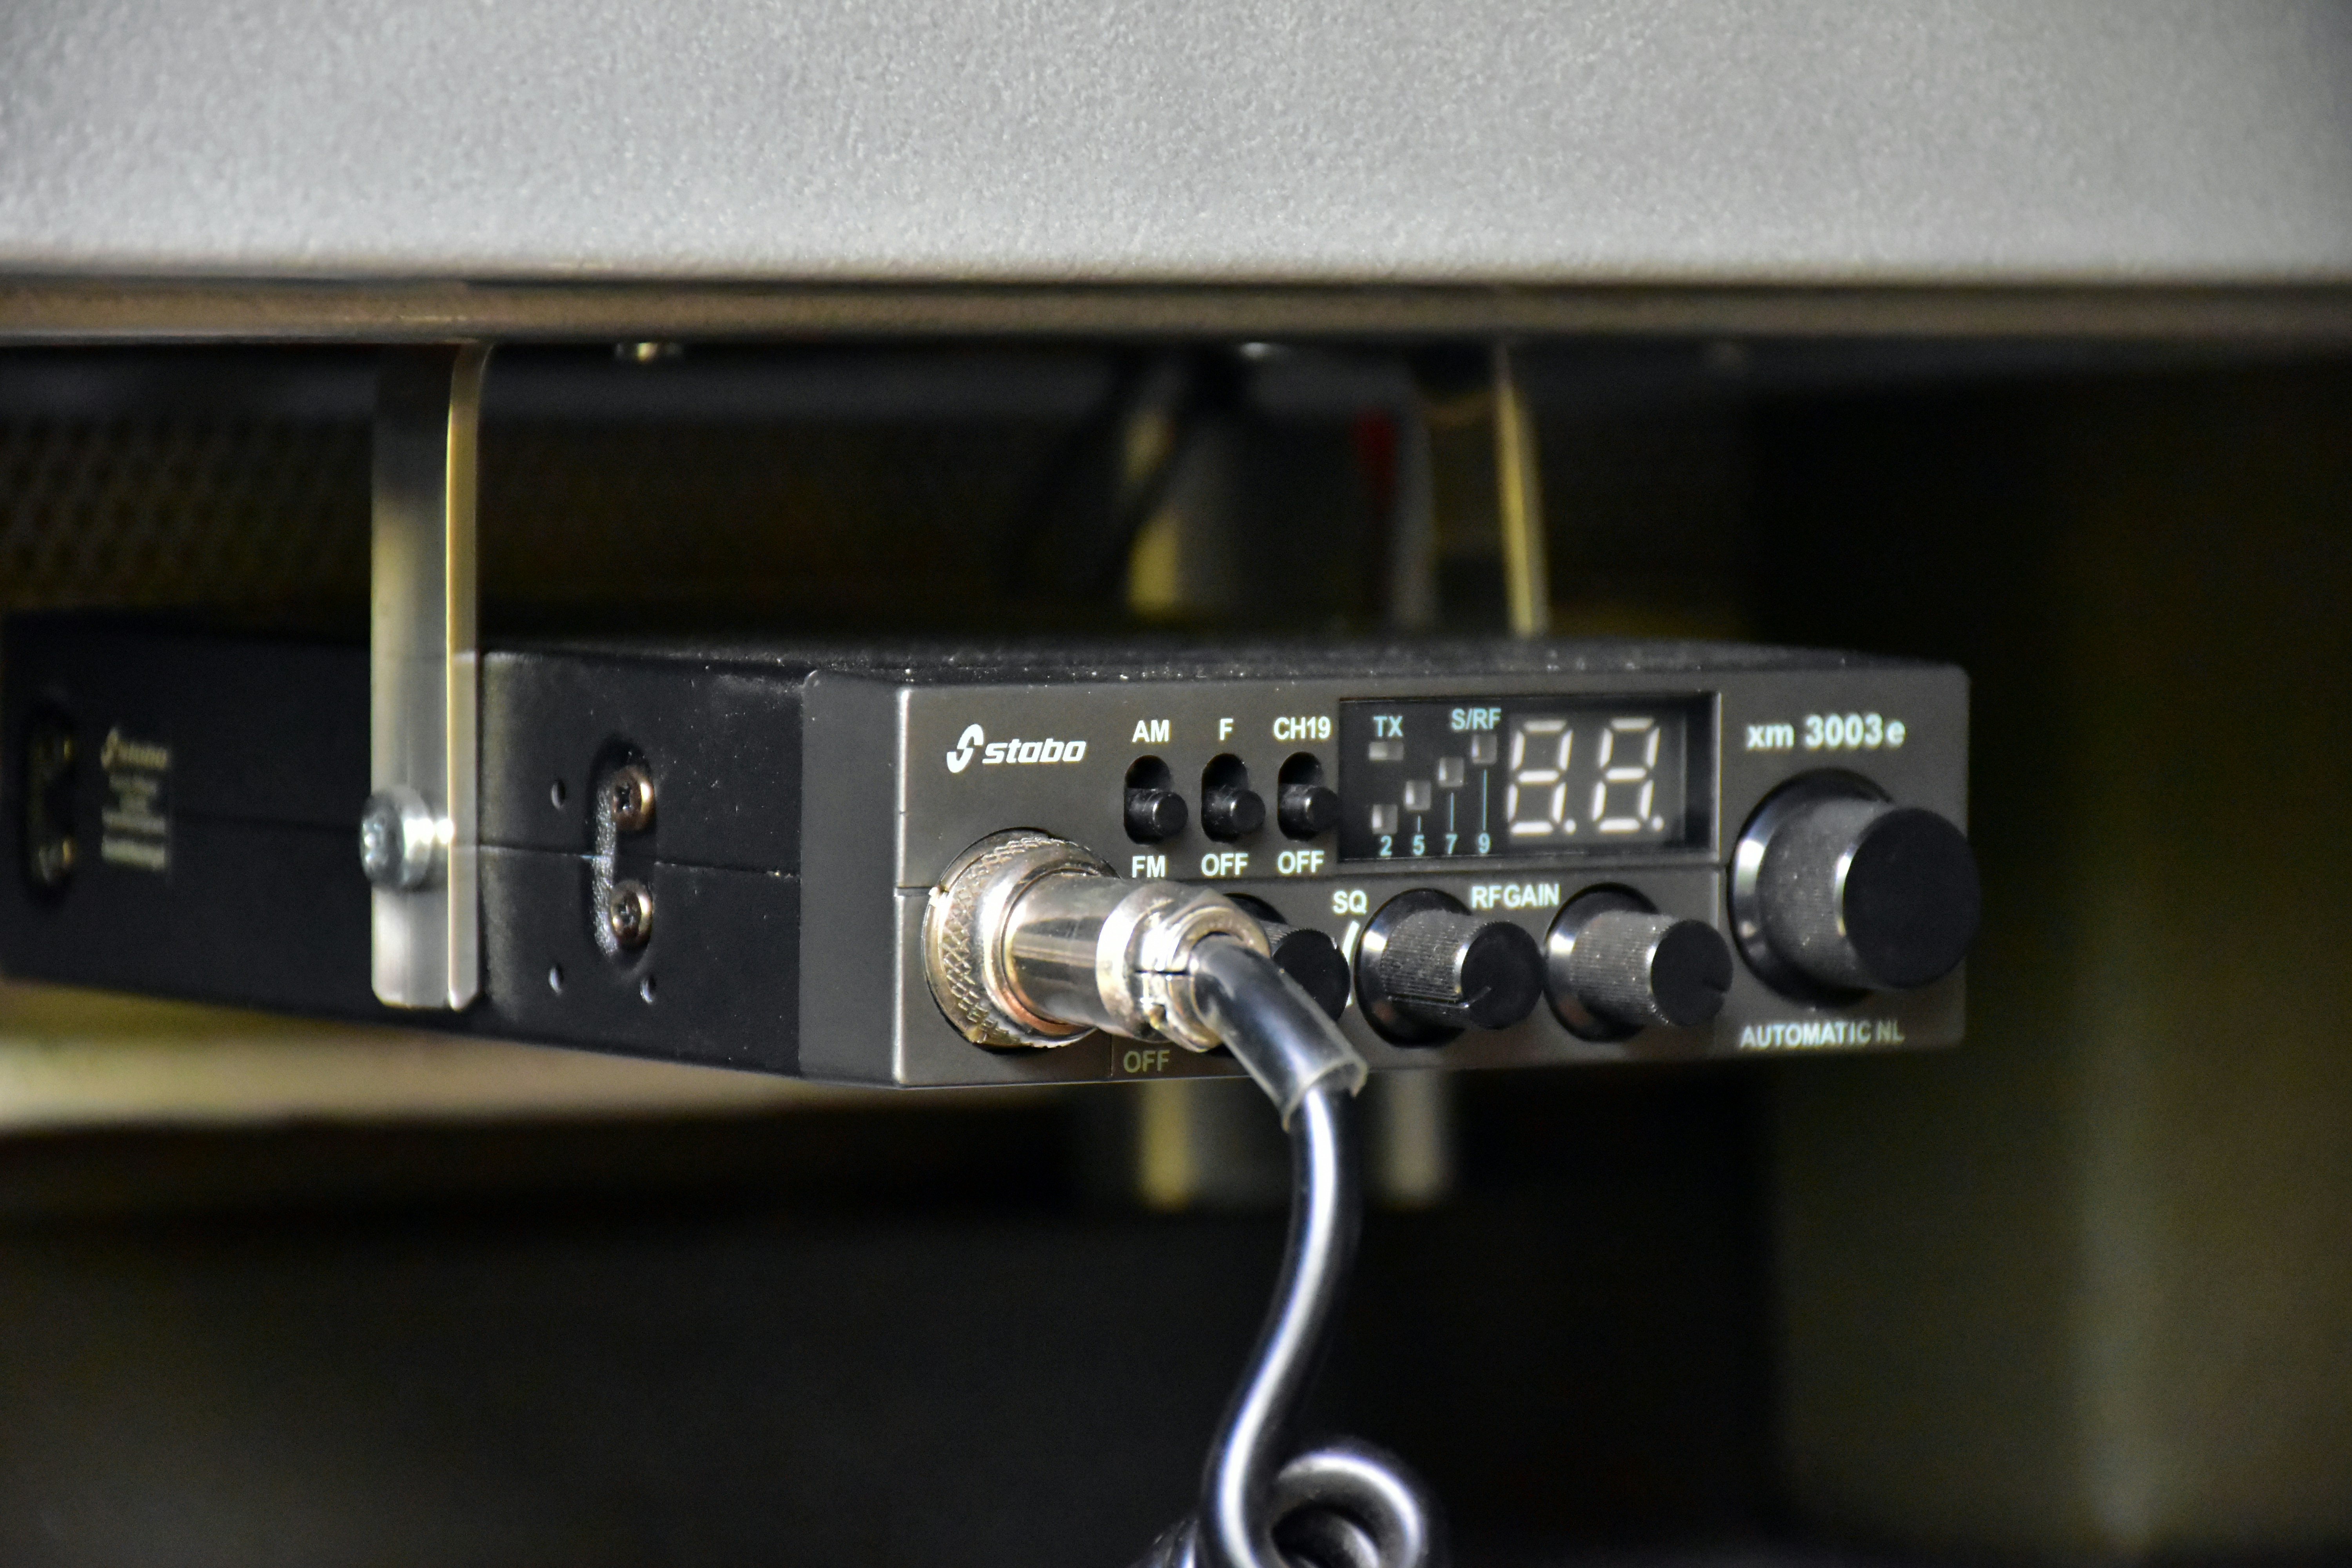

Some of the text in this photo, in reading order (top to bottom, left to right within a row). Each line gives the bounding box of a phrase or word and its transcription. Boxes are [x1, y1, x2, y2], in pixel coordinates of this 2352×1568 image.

[1132, 720, 1170, 743] AM
[1219, 718, 1234, 741] F
[1273, 716, 1331, 741] CH19
[1373, 715, 1403, 737] TX
[1451, 708, 1501, 731] S/RF
[1747, 724, 1794, 749] xm
[982, 738, 1087, 764] stabo
[1379, 832, 1490, 857] 2 5 7 9
[1132, 855, 1166, 878] FM
[1201, 852, 1249, 877] OFF
[1277, 850, 1324, 875] OFF
[1332, 889, 1368, 915] SQ
[1740, 1020, 1905, 1048] AUTOMATIC NL
[1123, 1050, 1170, 1073] OFF
